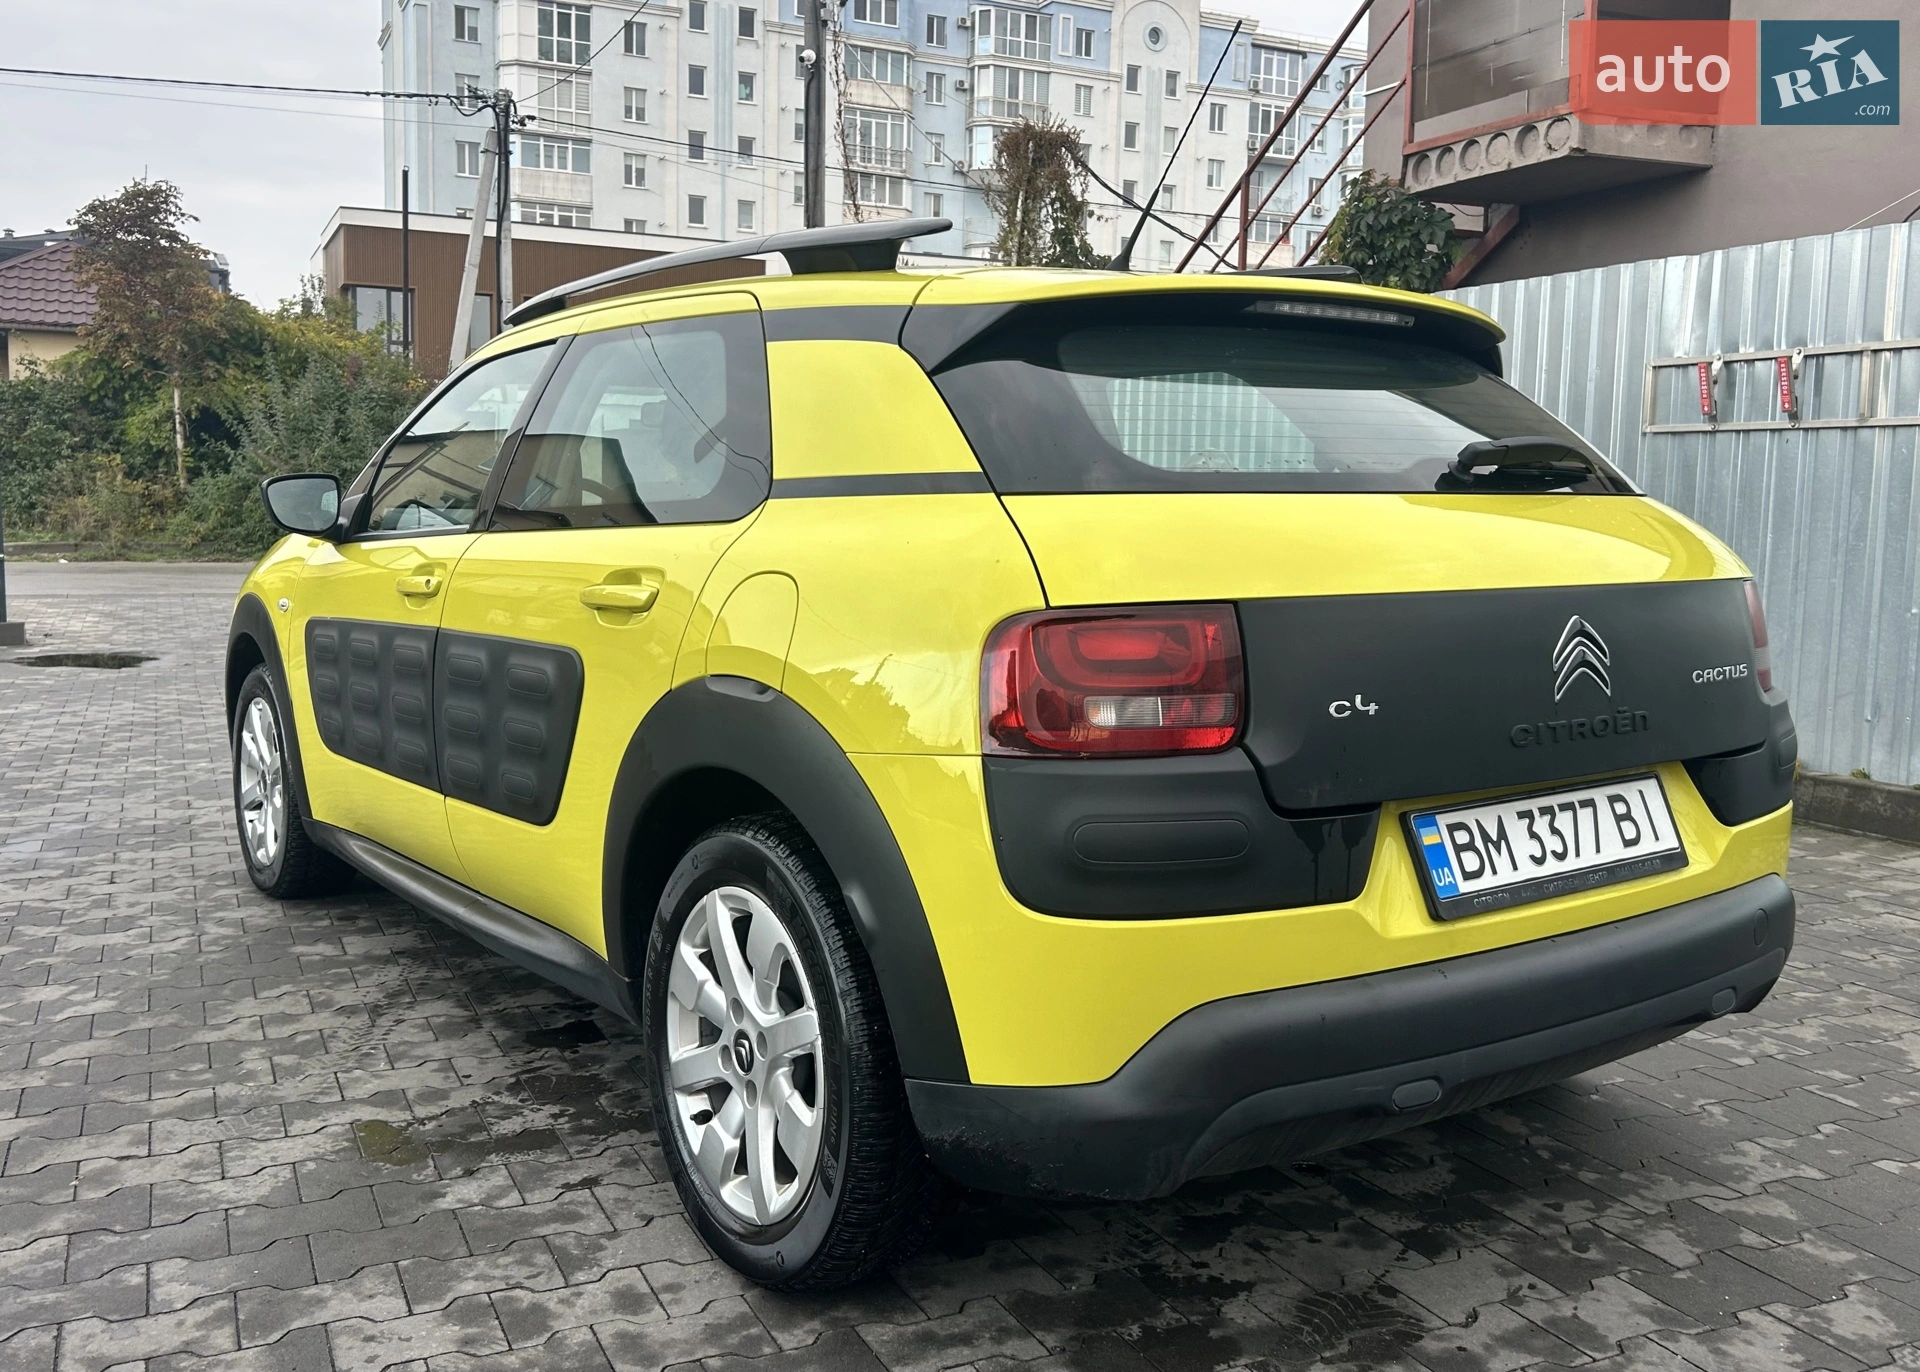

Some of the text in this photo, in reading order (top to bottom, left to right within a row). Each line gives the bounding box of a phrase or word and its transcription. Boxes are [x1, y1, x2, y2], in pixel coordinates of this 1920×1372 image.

[1692, 662, 1748, 684] CACTUS
[1445, 814, 1519, 881] BM
[1516, 798, 1601, 866] 3377
[1433, 866, 1455, 887] UA
